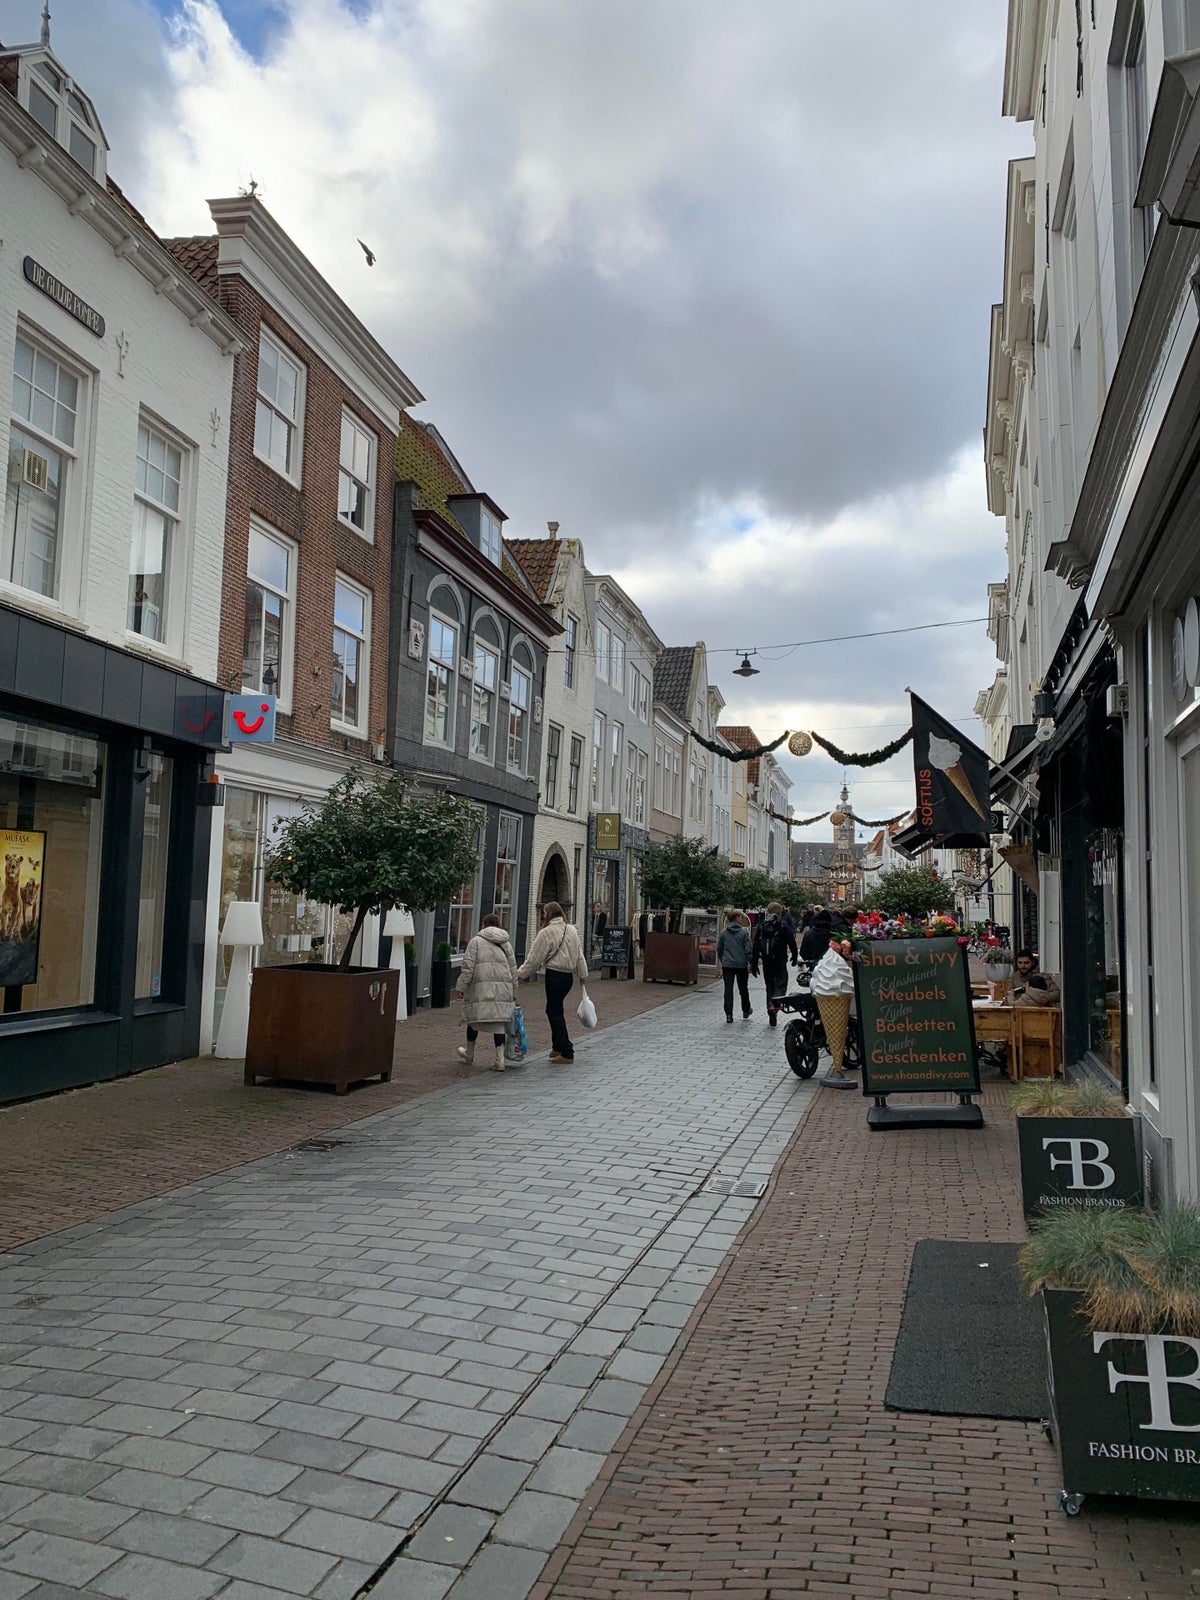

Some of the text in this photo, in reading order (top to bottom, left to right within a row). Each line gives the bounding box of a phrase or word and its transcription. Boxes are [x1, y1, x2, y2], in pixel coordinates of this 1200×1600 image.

[33, 263, 45, 288] DE
[920, 769, 933, 826] SOFTIJS
[863, 947, 958, 968] sha & ivy
[870, 962, 938, 996] Refashioned
[880, 985, 946, 1002] Meubels
[876, 1017, 956, 1033] Boeketten
[871, 1046, 967, 1064] Geschenken
[872, 1070, 969, 1080] www.shaandivy.com
[1040, 1196, 1125, 1208] FASHION BRANDS
[1089, 1442, 1200, 1464] FASHION BR
